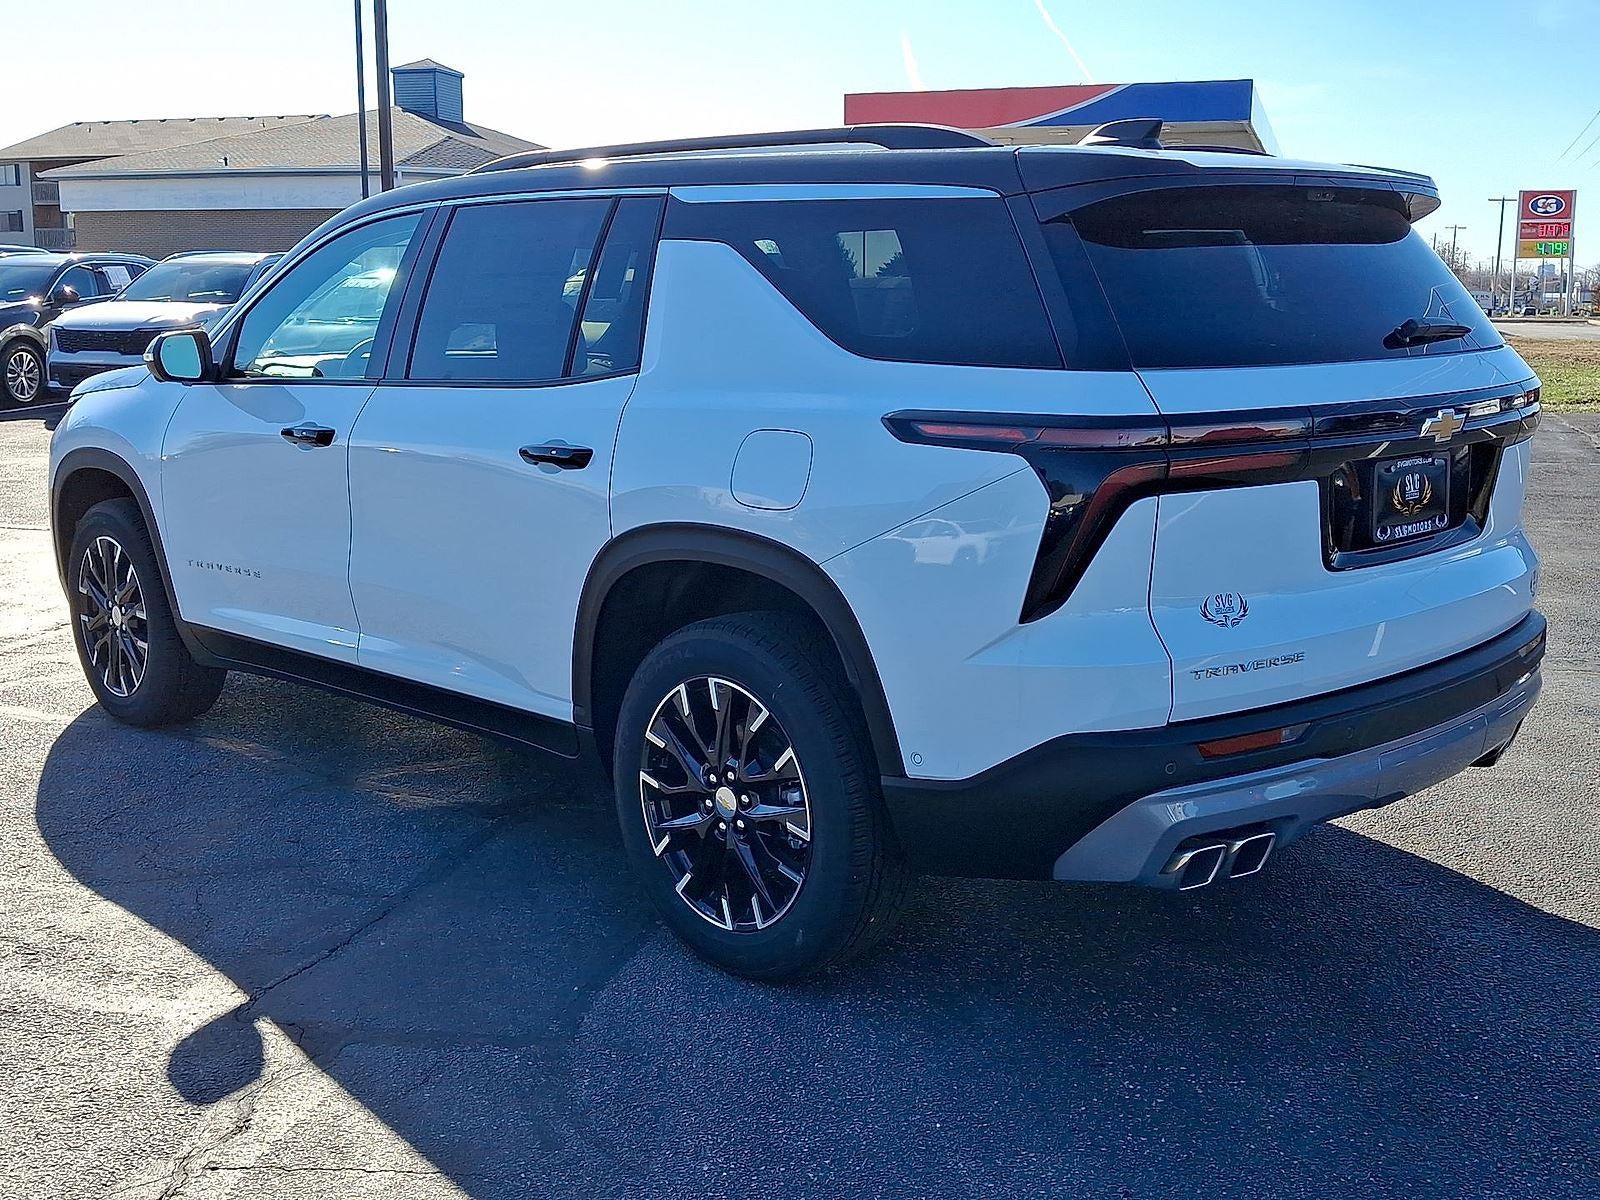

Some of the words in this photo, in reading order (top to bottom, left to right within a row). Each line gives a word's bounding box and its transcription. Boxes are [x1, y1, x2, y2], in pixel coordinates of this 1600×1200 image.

[186, 559, 263, 579] TRAVERSE
[1214, 593, 1233, 608] SVG
[1190, 651, 1306, 681] TRAVERSE
